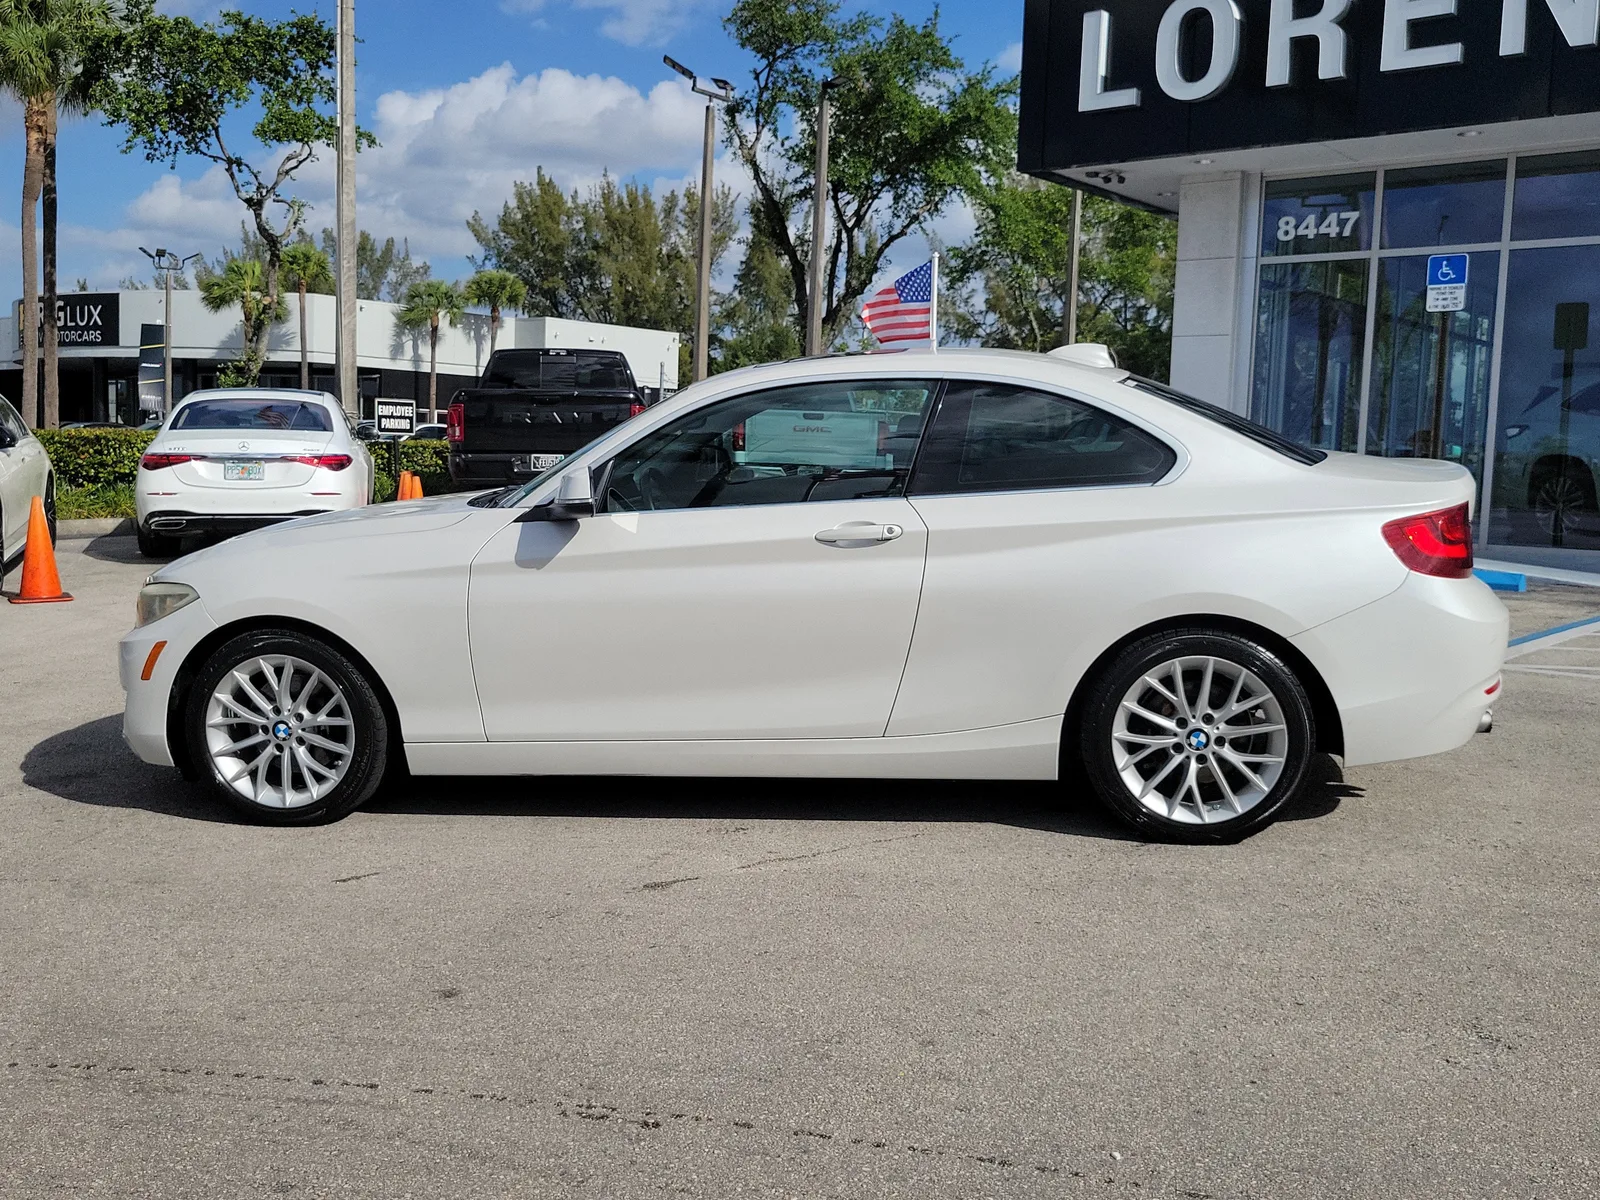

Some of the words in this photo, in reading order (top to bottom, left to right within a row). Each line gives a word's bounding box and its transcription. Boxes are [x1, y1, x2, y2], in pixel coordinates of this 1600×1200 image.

[1277, 211, 1360, 241] 8447
[378, 404, 414, 417] EMPLOYEE
[381, 417, 410, 430] PARKING
[793, 425, 832, 433] GMC
